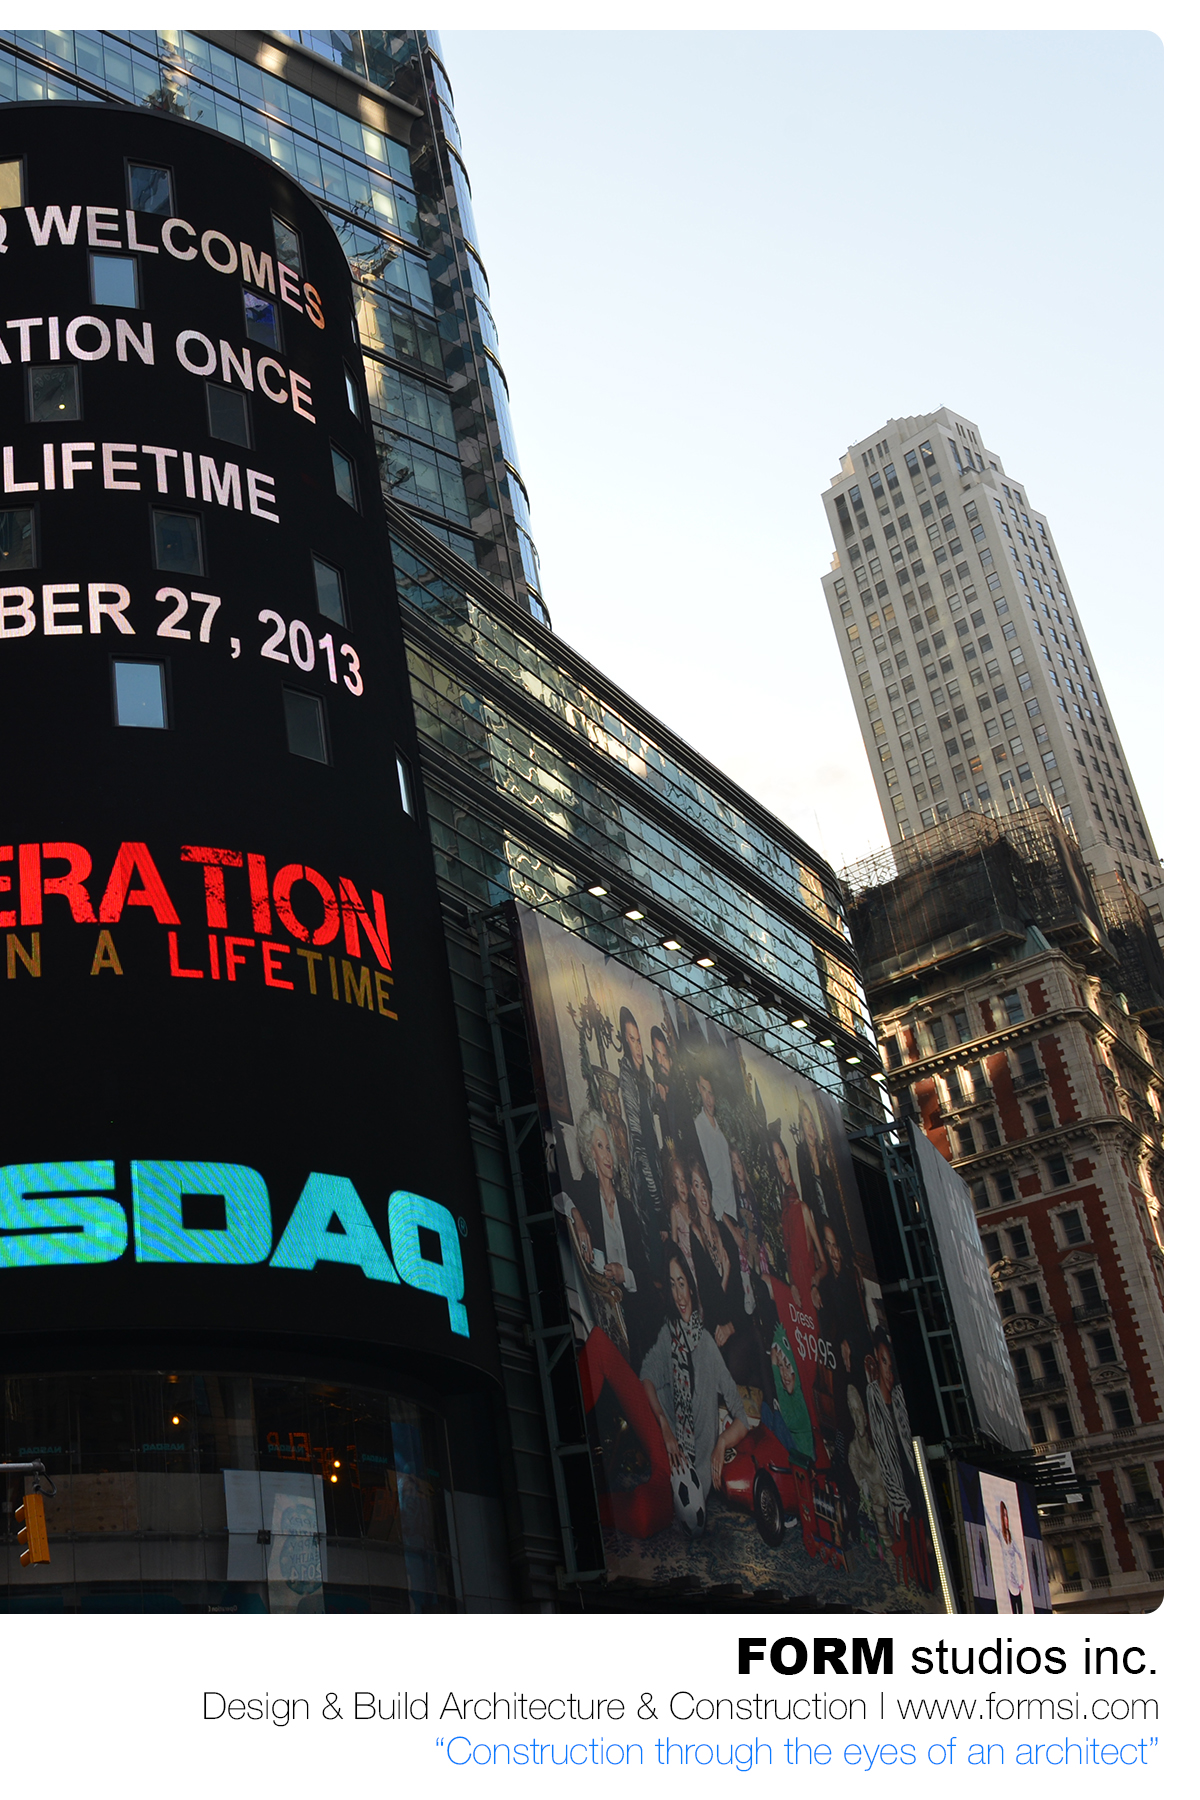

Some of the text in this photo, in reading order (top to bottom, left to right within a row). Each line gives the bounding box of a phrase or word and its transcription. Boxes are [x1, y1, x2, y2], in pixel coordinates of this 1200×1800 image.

[24, 205, 326, 330] WELCOMES
[175, 329, 316, 424] ONCE
[3, 442, 280, 523] LIFETIME
[257, 609, 364, 697] 2013
[90, 929, 124, 976] A
[168, 931, 399, 1021] LIFETIME
[789, 1303, 815, 1330] Dress
[794, 1327, 837, 1370] $19.95
